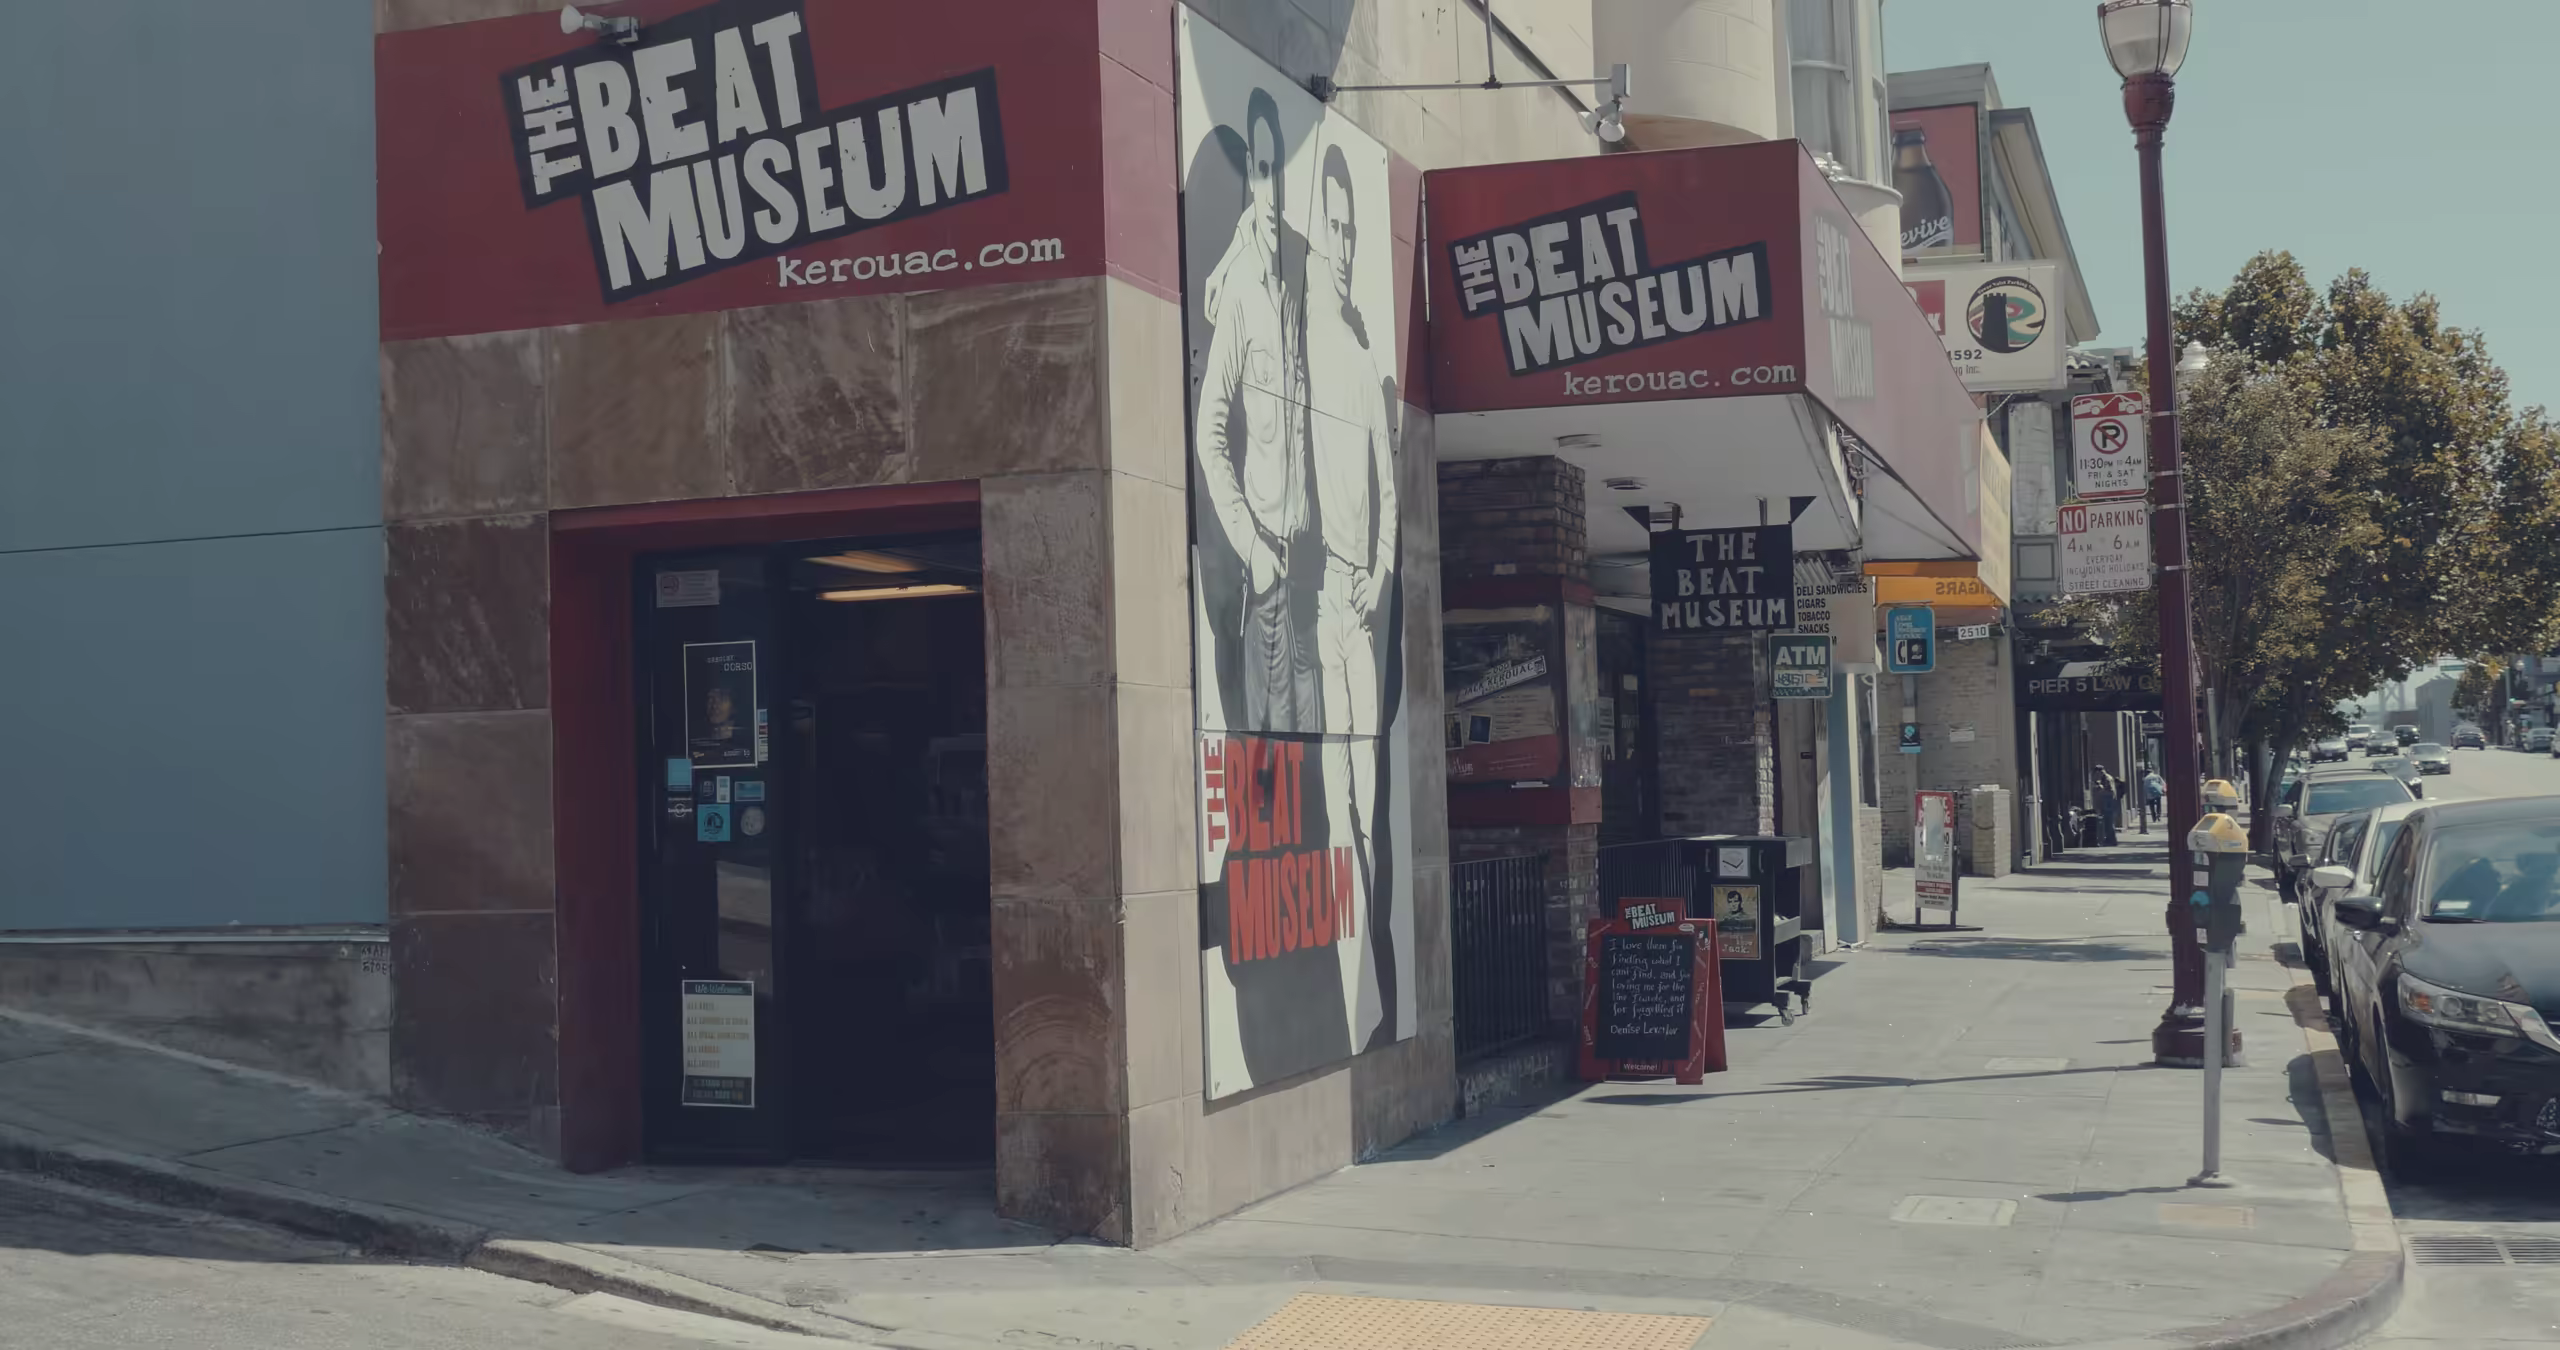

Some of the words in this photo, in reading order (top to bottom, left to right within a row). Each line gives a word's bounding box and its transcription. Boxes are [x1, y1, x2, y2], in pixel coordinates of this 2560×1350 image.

[574, 11, 802, 180] BEAT
[517, 65, 582, 195] THE
[592, 87, 987, 291] MUSEUM
[1901, 216, 1951, 246] evive
[777, 237, 1065, 288] kerouac.com
[1493, 207, 1639, 304] BEAT
[1455, 240, 1496, 311] THE
[1503, 252, 1759, 371] MUSEUM
[1563, 363, 1797, 396] kerouac.com
[2088, 471, 2102, 480] FRI
[2107, 470, 2113, 479] &
[2117, 469, 2135, 478] SAT
[2095, 479, 2129, 488] NIGHTS
[2062, 509, 2085, 532] NO
[2090, 509, 2143, 529] PARKING
[1686, 532, 1756, 562] THE
[2086, 554, 2123, 565] EVERYDAY
[2109, 562, 2144, 573] HOLIDAYS
[1677, 566, 1764, 597] BEAT
[1797, 585, 1814, 597] DELI
[1815, 583, 1867, 595] SANDWICHES
[2068, 581, 2099, 591] STREET
[2102, 578, 2144, 589] CLEANING
[1797, 598, 1826, 609] CIGARS
[1661, 598, 1787, 630] MUSEUM
[1797, 611, 1831, 622] TOBACCO
[1798, 623, 1829, 634] SNACKS
[1960, 626, 1986, 638] 2510
[1776, 646, 1826, 666] ATM
[1486, 661, 1534, 686] KEROUAC
[2029, 679, 2070, 694] PIER
[2076, 677, 2088, 692] 5
[2092, 675, 2132, 692] LAW
[1204, 738, 1226, 852] THE
[1225, 738, 1304, 852] BEAT
[1228, 846, 1355, 965] MUSEUM
[1631, 903, 1657, 918] BEAT
[1632, 911, 1675, 930] MUSEUM
[1609, 938, 1617, 951] I
[1623, 938, 1642, 950] love
[1646, 937, 1667, 950] them
[1676, 955, 1681, 966] I
[1660, 969, 1676, 979] and
[1612, 978, 1641, 992] loving
[1643, 983, 1654, 991] me
[1672, 981, 1685, 992] the
[1670, 994, 1685, 1002] and
[1613, 1004, 1627, 1016] for
[1610, 1023, 1641, 1035] Denise
